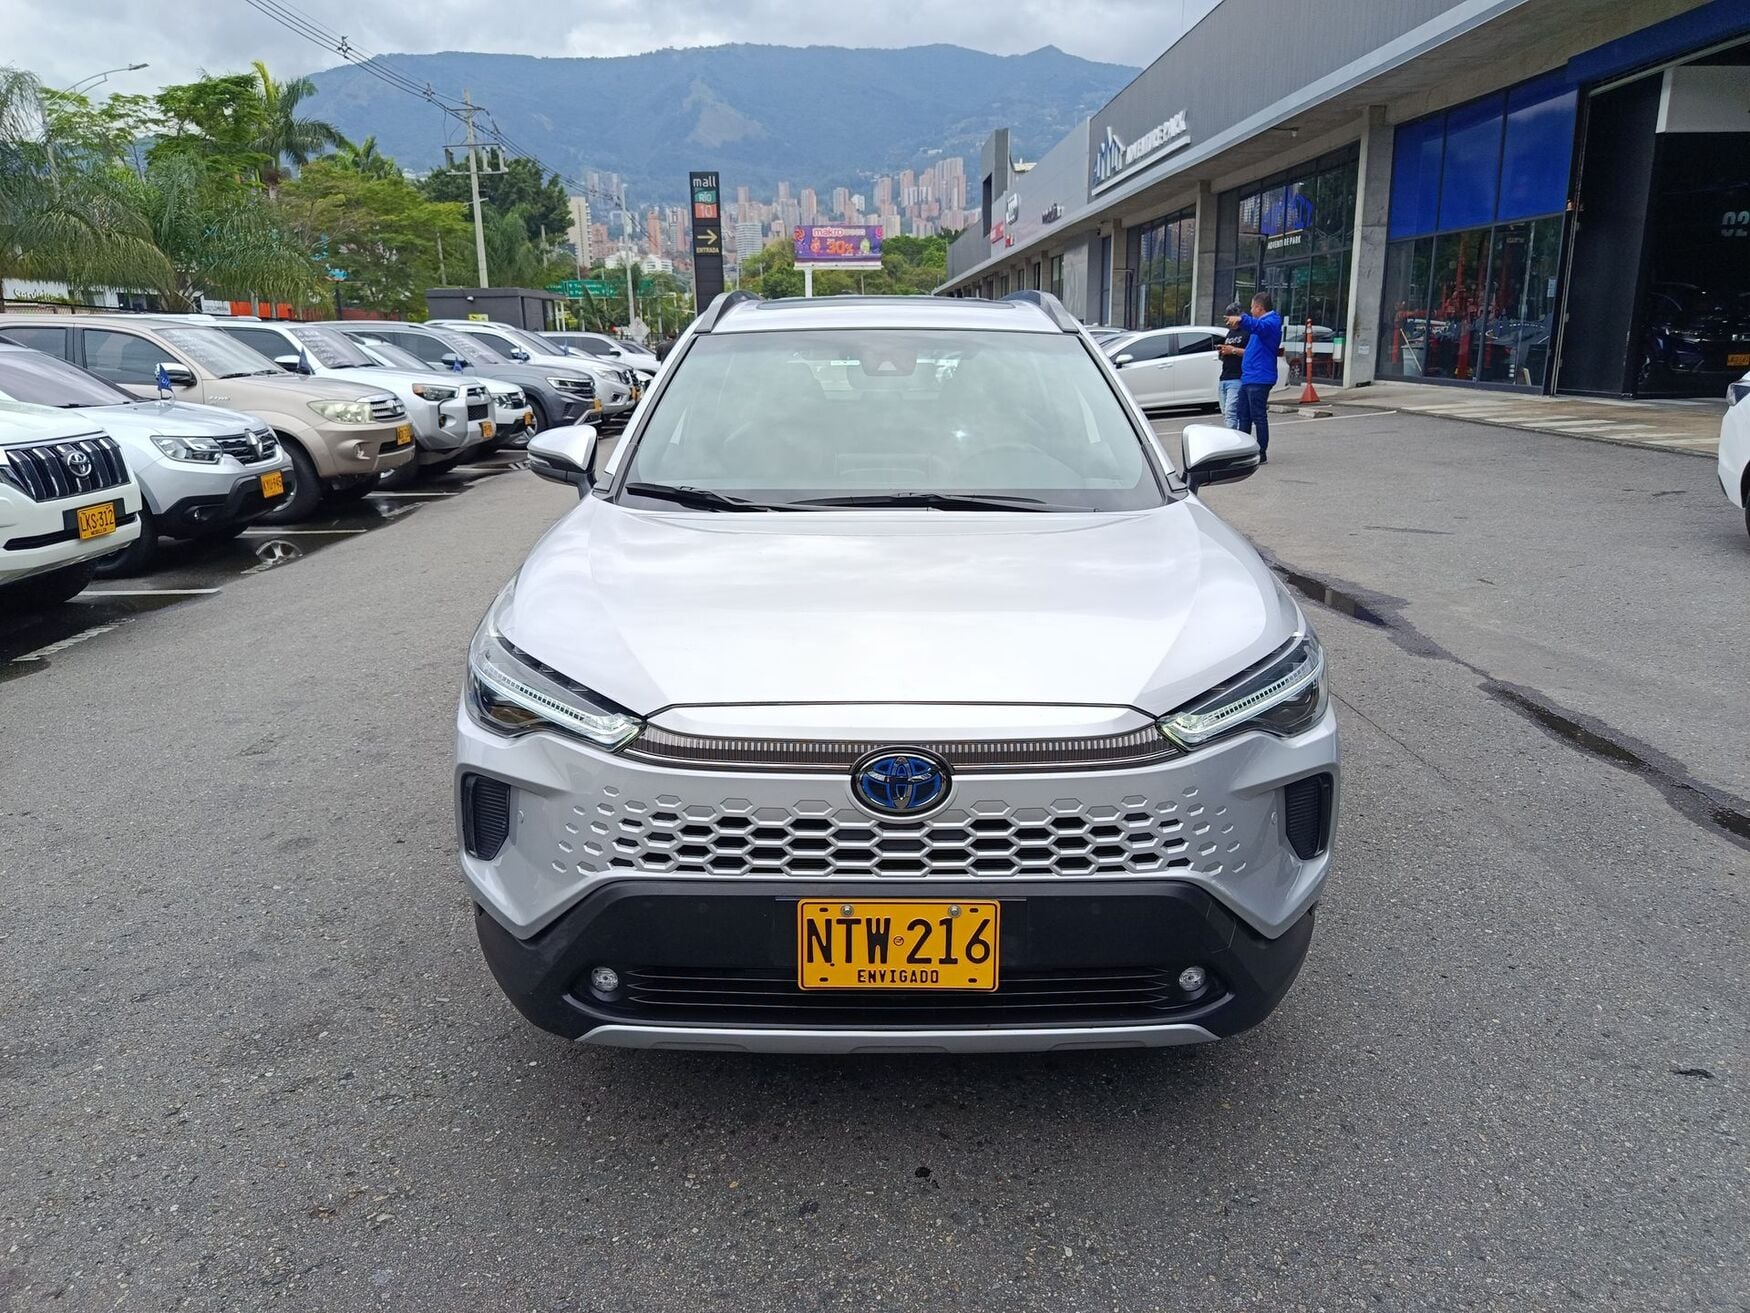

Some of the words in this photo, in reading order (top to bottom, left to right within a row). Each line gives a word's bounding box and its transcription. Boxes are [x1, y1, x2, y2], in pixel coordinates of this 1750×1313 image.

[693, 176, 716, 187] mall
[813, 227, 843, 237] makro
[98, 509, 114, 527] 312
[806, 917, 891, 964] NTW
[906, 918, 991, 964] 216
[857, 969, 939, 983] ENVIGADO
